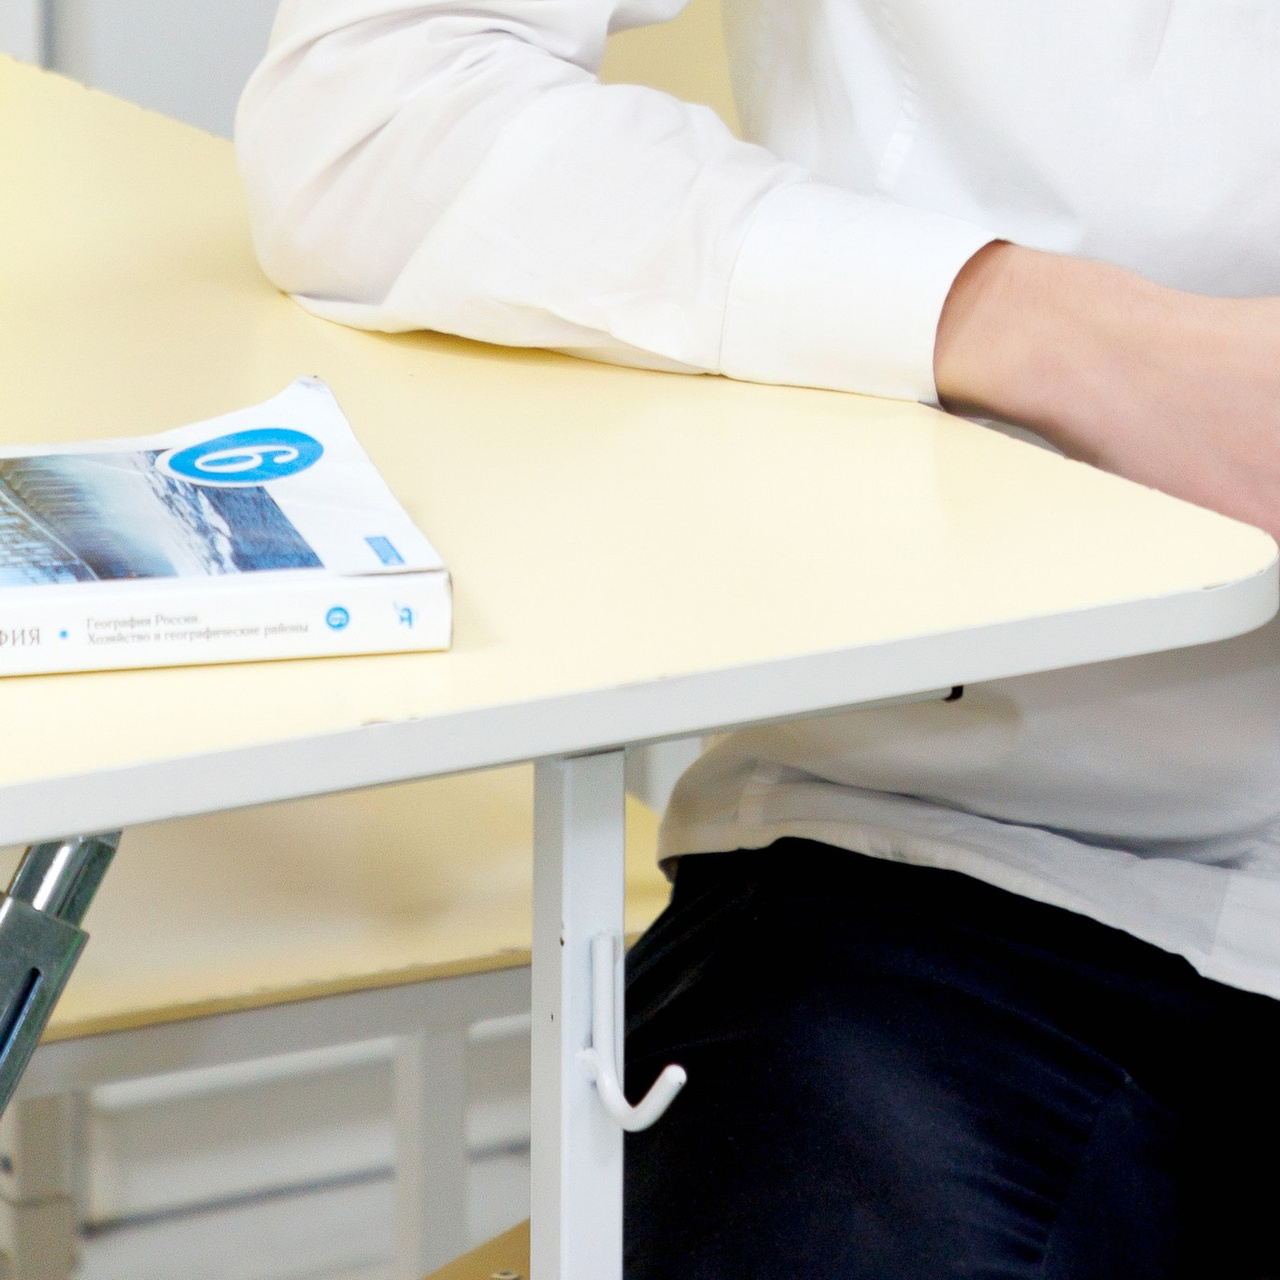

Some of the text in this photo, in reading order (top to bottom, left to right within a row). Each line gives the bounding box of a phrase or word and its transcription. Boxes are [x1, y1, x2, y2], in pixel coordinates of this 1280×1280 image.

[86, 613, 198, 634] География России
[87, 623, 308, 645] Хозяйство и географические районы
